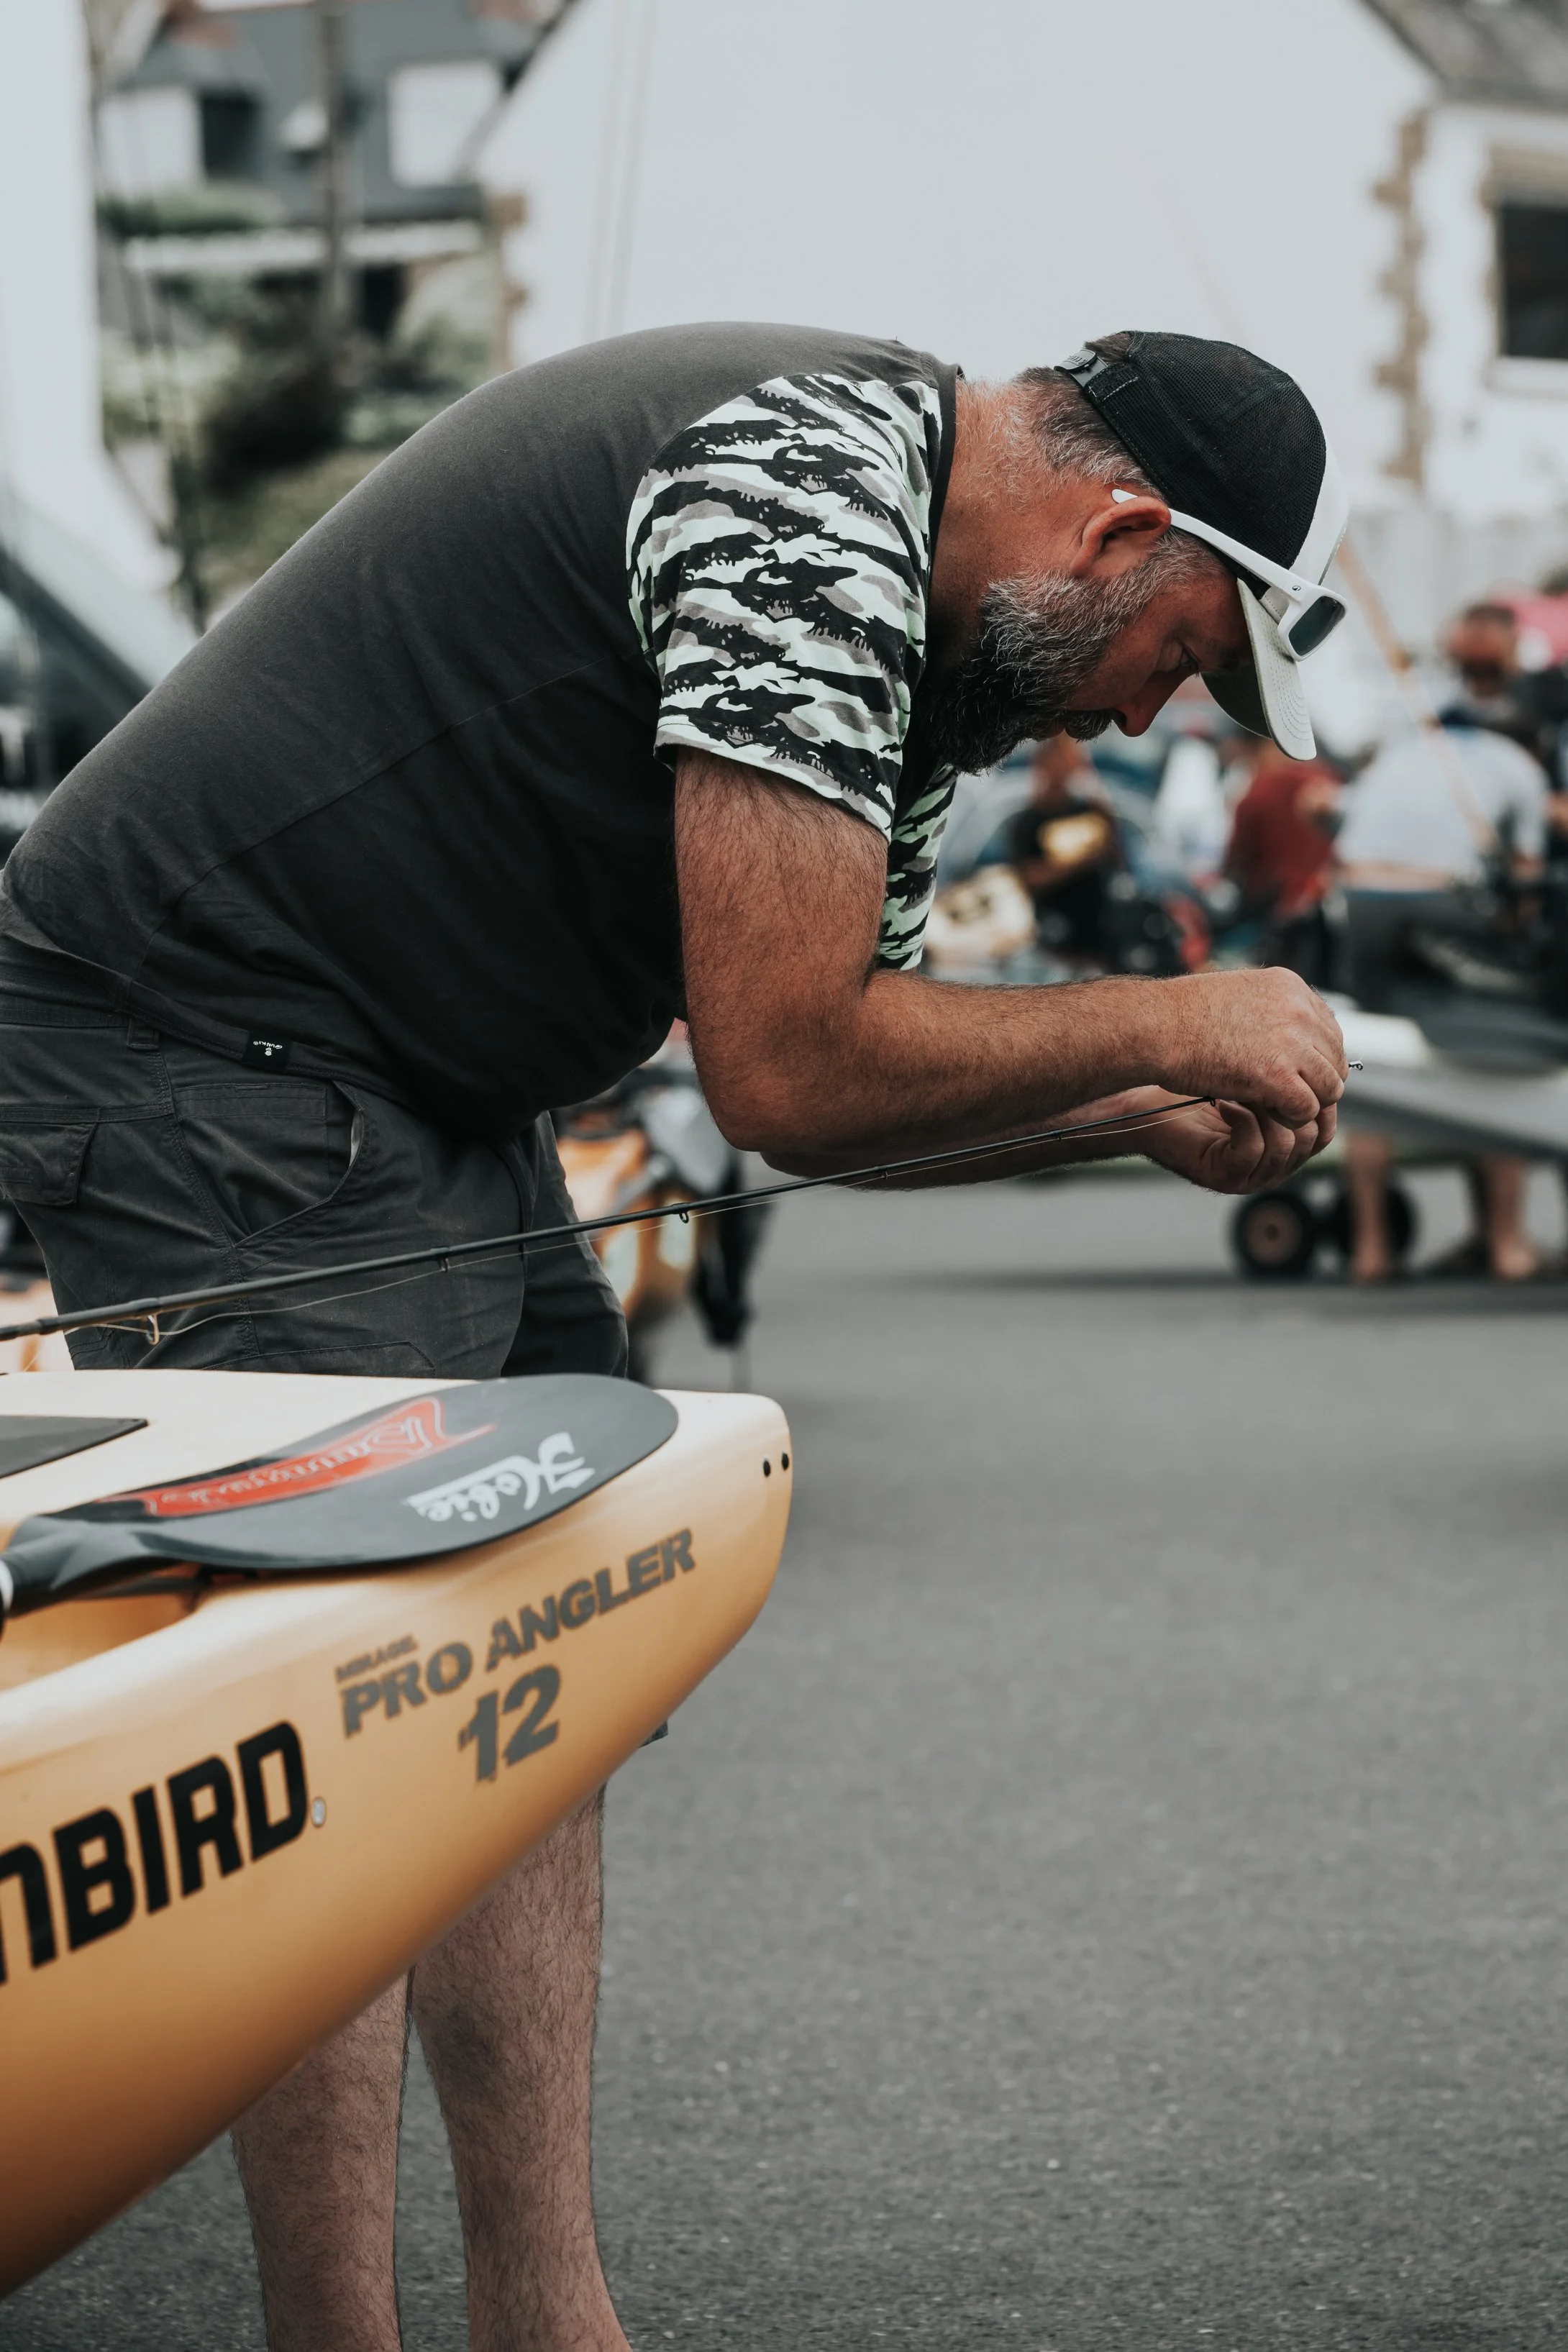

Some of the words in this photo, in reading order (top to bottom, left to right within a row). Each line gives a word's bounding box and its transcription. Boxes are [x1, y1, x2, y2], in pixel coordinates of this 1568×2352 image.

[340, 1641, 473, 1740] PRO
[485, 1528, 697, 1673] ANGLER
[457, 1664, 562, 1784] 12
